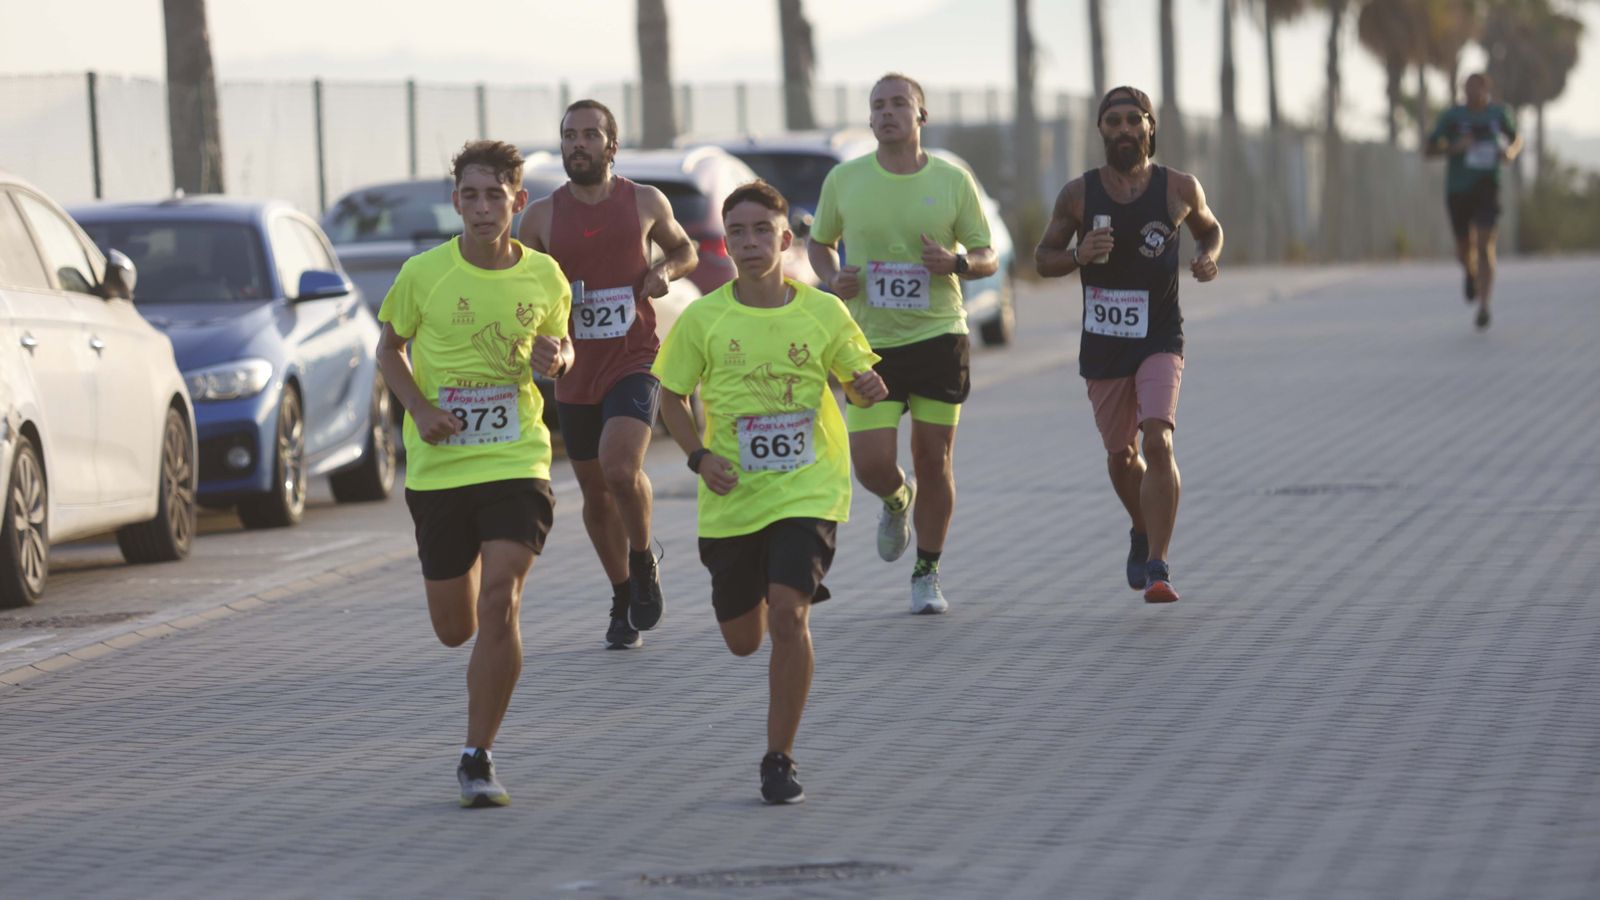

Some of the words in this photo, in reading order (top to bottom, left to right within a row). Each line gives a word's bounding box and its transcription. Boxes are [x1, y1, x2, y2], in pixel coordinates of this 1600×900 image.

[875, 277, 921, 298] 162
[580, 304, 626, 328] 921
[1094, 304, 1139, 327] 905
[487, 392, 513, 402] MUJER
[451, 405, 508, 431] 873
[750, 432, 805, 459] 663
